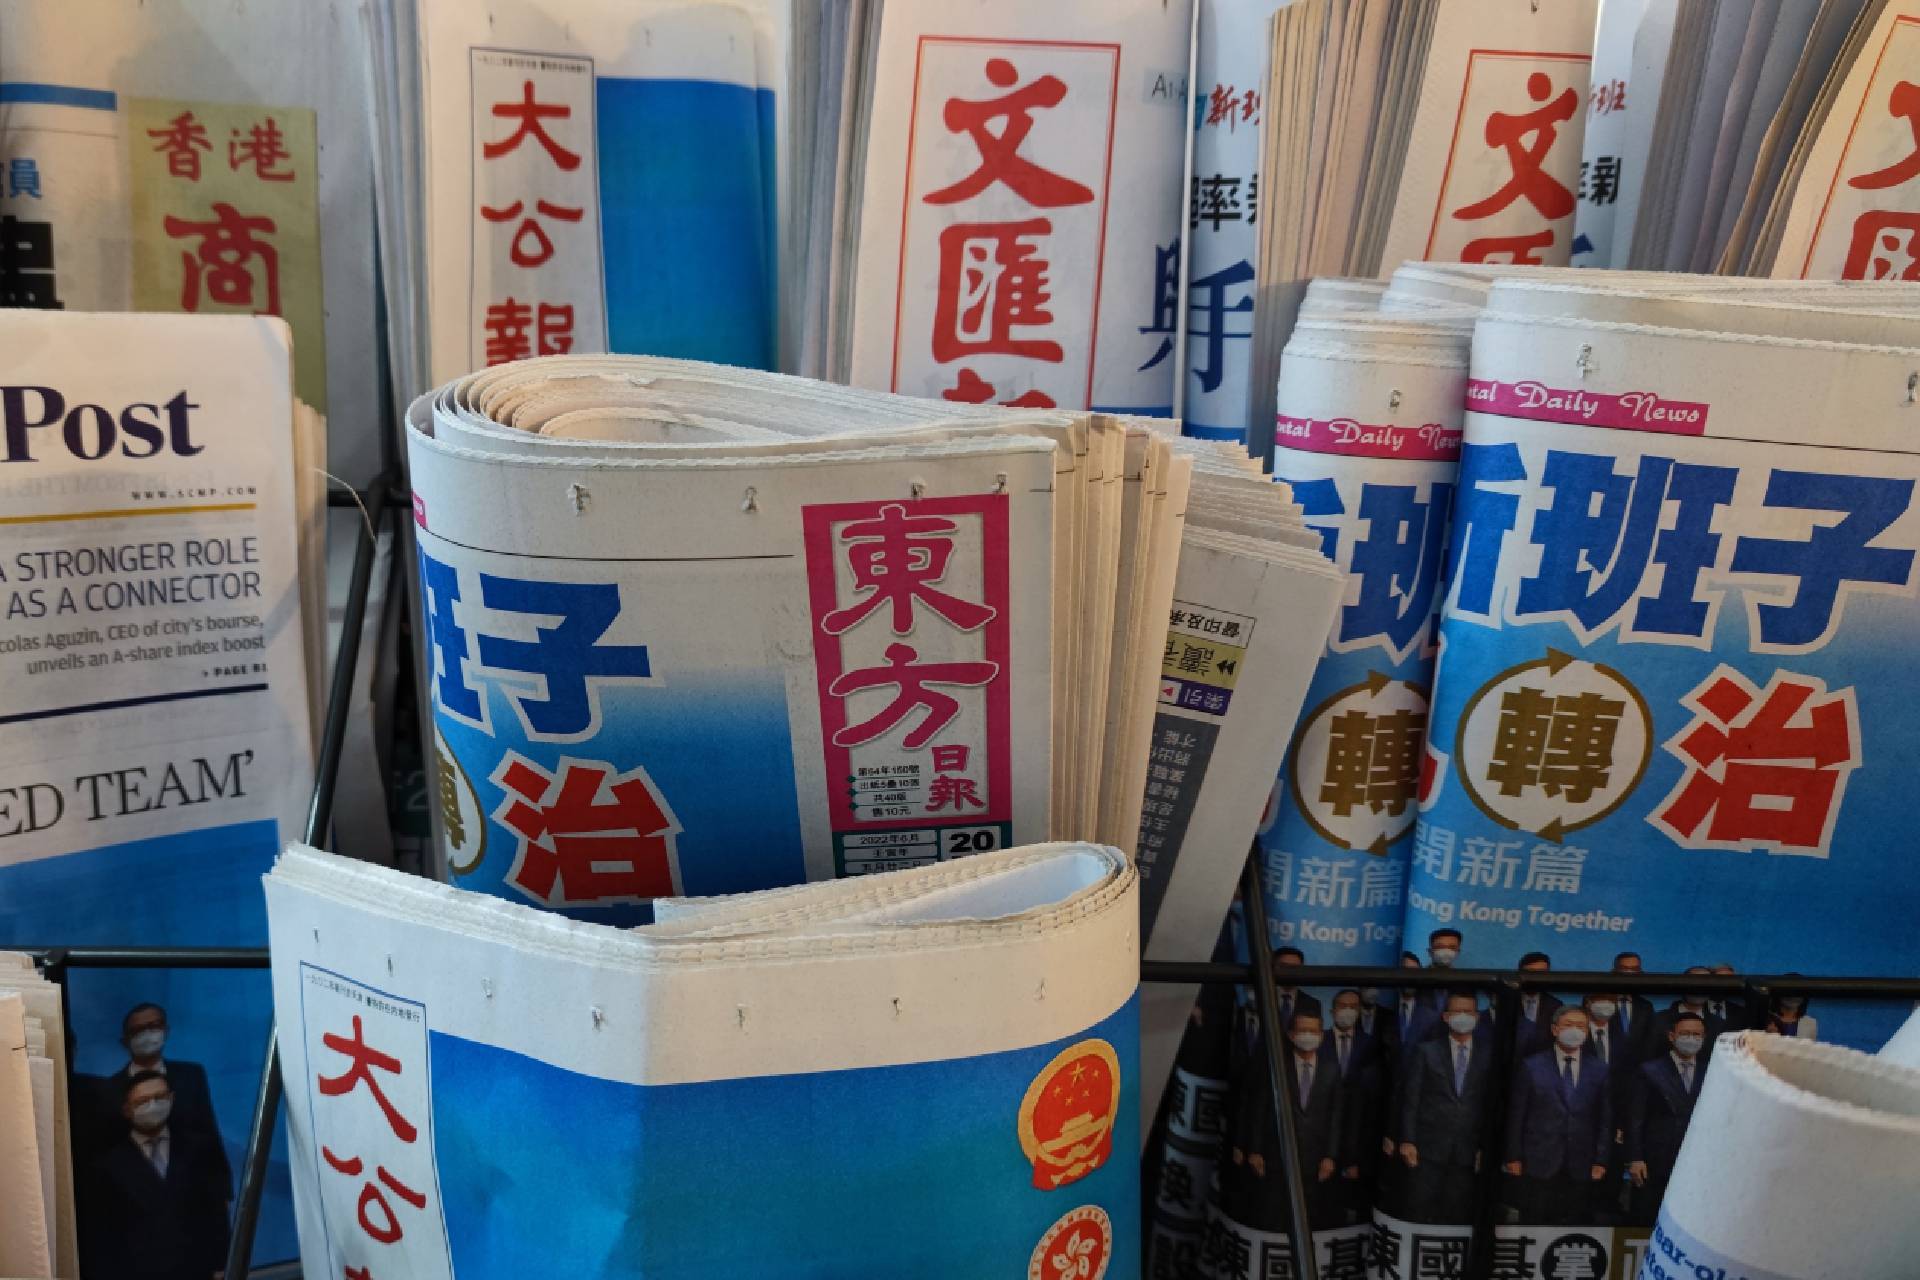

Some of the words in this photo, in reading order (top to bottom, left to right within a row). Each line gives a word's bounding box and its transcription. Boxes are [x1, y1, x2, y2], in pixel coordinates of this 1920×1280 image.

[147, 111, 295, 182] 香港
[481, 80, 584, 367] 大公報
[164, 203, 281, 316] 商
[1514, 382, 1599, 419] Daily
[1619, 394, 1701, 423] News
[0, 386, 205, 463] Post
[1328, 420, 1405, 452] Daily
[16, 541, 176, 582] STRONGER
[185, 536, 260, 569] ROLE
[6, 589, 47, 620] AS
[56, 587, 78, 615] A
[85, 571, 261, 612] CONNECTOR
[108, 624, 139, 641] CEO
[143, 621, 158, 637] of
[26, 656, 85, 675] unveils
[88, 652, 109, 667] an
[112, 643, 173, 664] A-share
[177, 639, 219, 657] index
[949, 829, 995, 853] 20
[1300, 918, 1359, 947] Kong
[1460, 900, 1521, 929] Kong
[1528, 906, 1634, 933] Together
[317, 1014, 428, 1280] 大公
